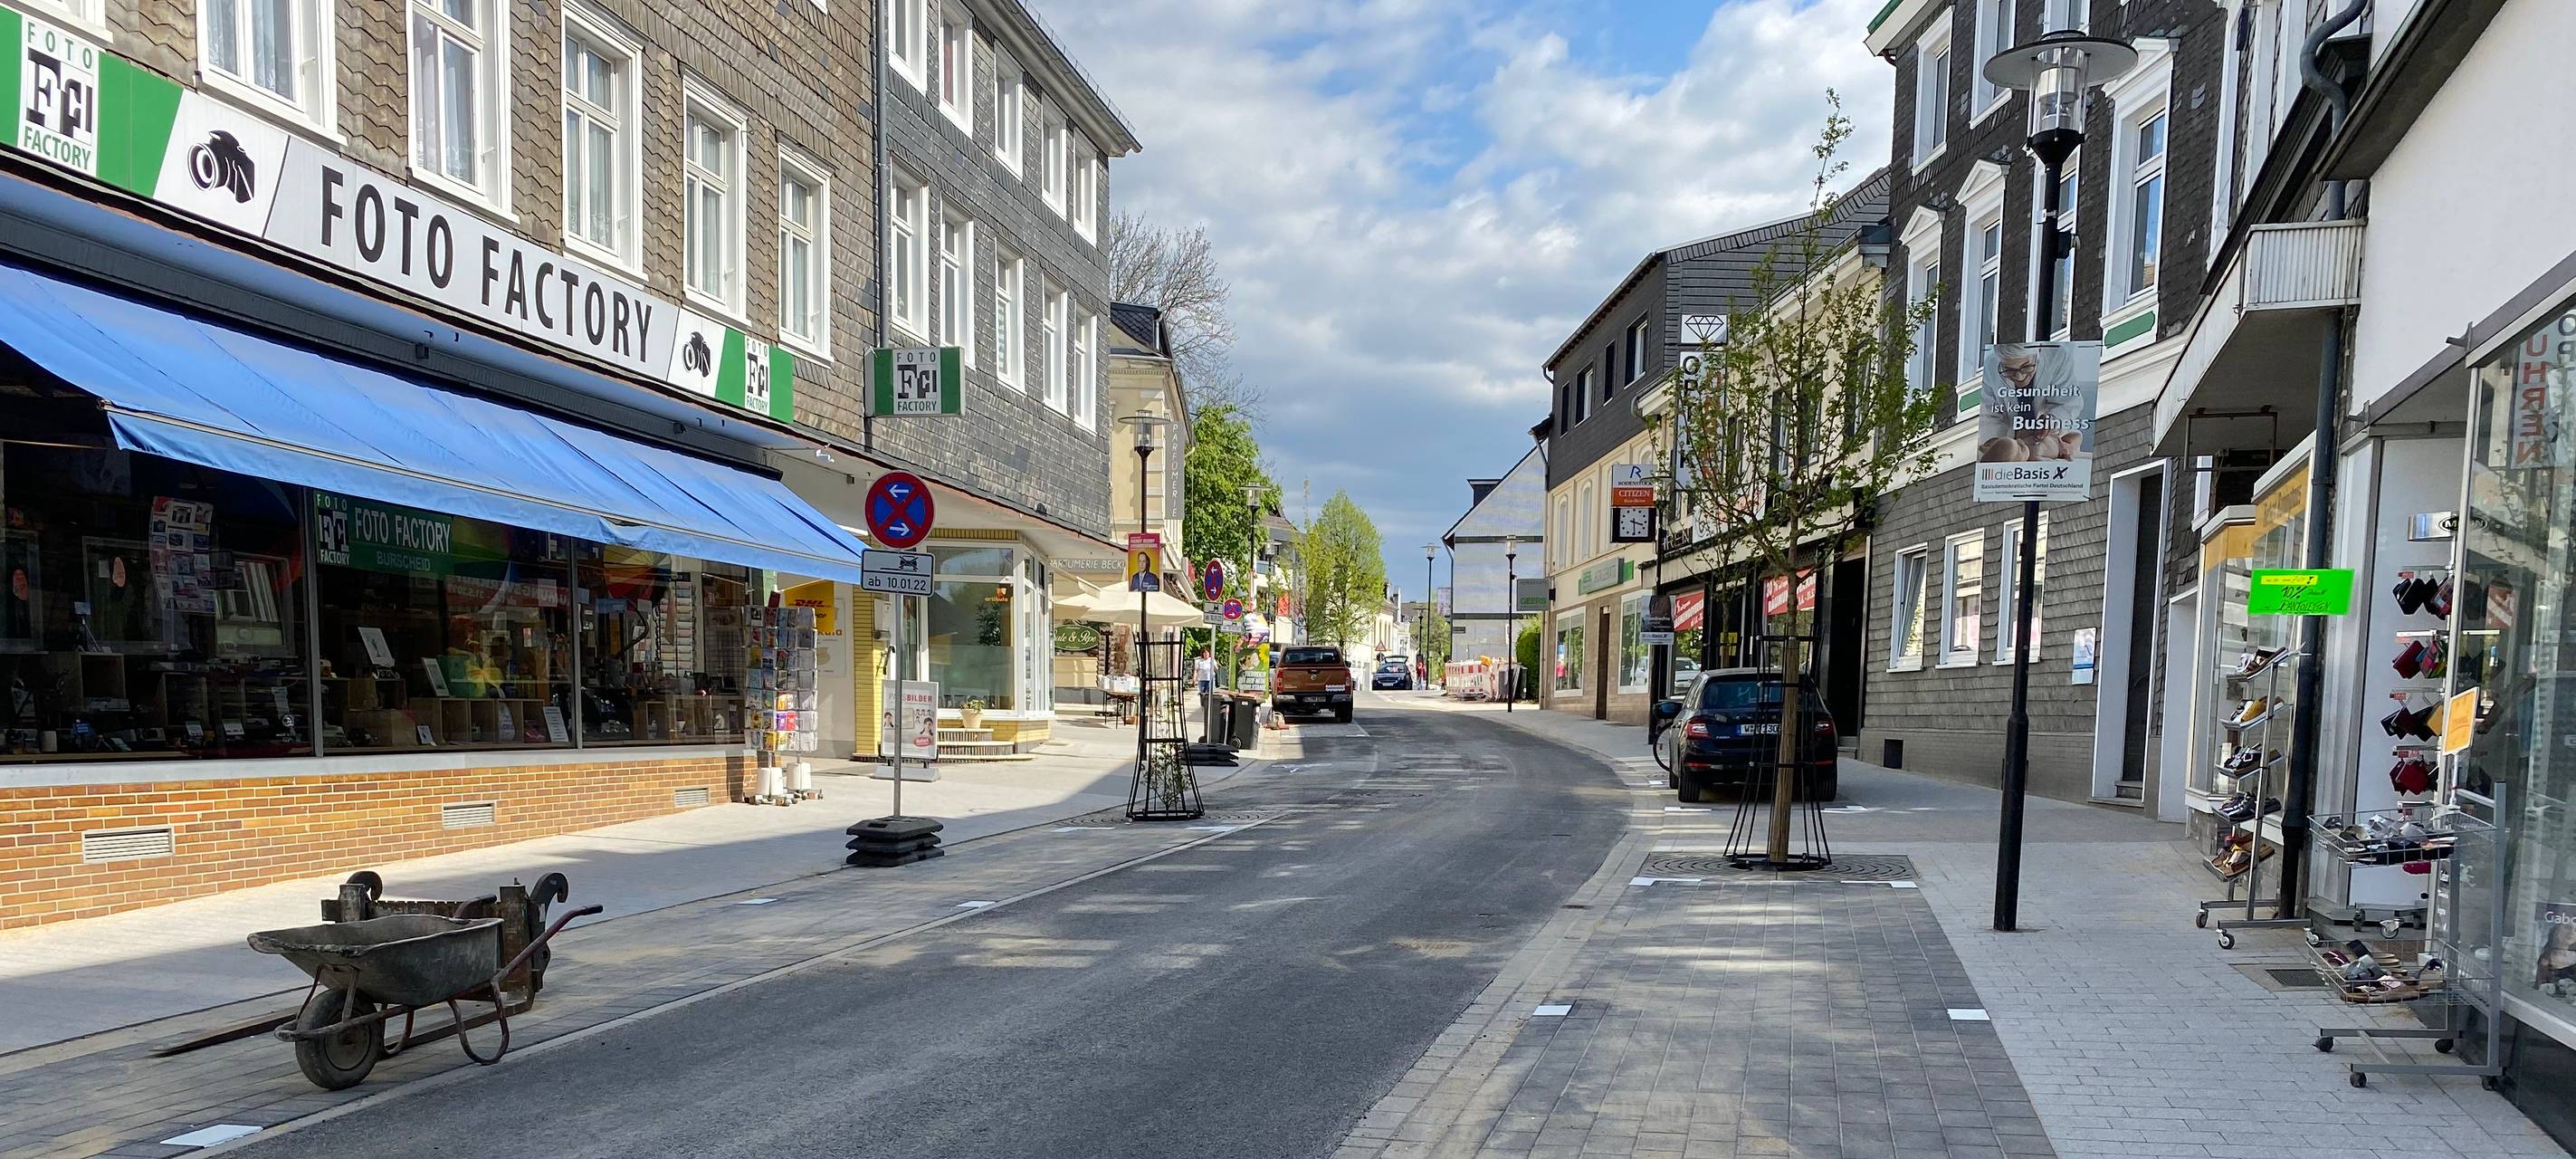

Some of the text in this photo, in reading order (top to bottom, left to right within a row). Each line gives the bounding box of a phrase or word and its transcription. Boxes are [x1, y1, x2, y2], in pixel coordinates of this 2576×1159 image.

[27, 21, 93, 70] FOTO
[24, 125, 91, 170] FACTORY
[320, 165, 654, 364] FOTO FACTORY
[746, 338, 769, 358] FOTO
[896, 351, 937, 363] FOTO
[1997, 384, 2082, 398] Gesundheit
[746, 394, 768, 413] FACTORY
[896, 399, 938, 412] FACTORY
[1990, 402, 2031, 413] ist kein
[2012, 416, 2090, 431] Business
[1995, 467, 2050, 481] dieBasis
[317, 493, 348, 511] FOTO
[354, 506, 451, 553] FOTO FACTORY
[320, 550, 350, 566] FACTORY
[376, 551, 432, 571] BURSCHEID
[868, 577, 927, 591] ab 10.01.22
[1068, 631, 1077, 642] &
